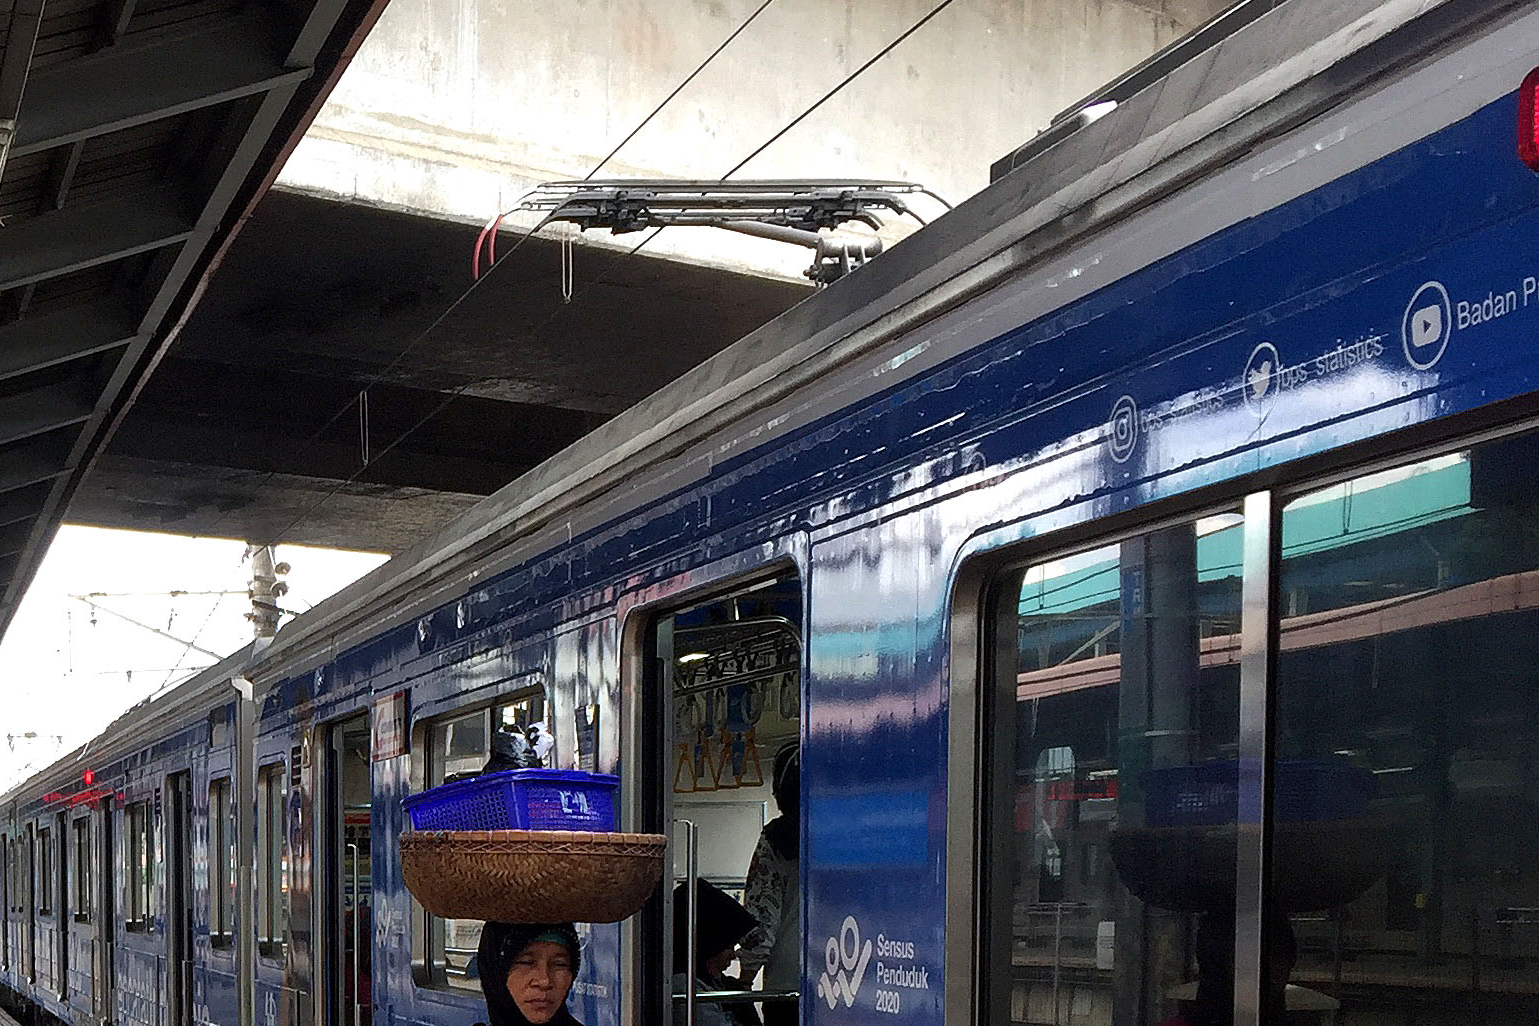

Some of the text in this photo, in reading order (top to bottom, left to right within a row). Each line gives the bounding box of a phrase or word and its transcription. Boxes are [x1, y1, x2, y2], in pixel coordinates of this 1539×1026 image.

[1457, 276, 1539, 330] Badan P
[877, 933, 915, 960] Sensus
[876, 961, 929, 989] Penduduk
[875, 990, 901, 1014] 2020
